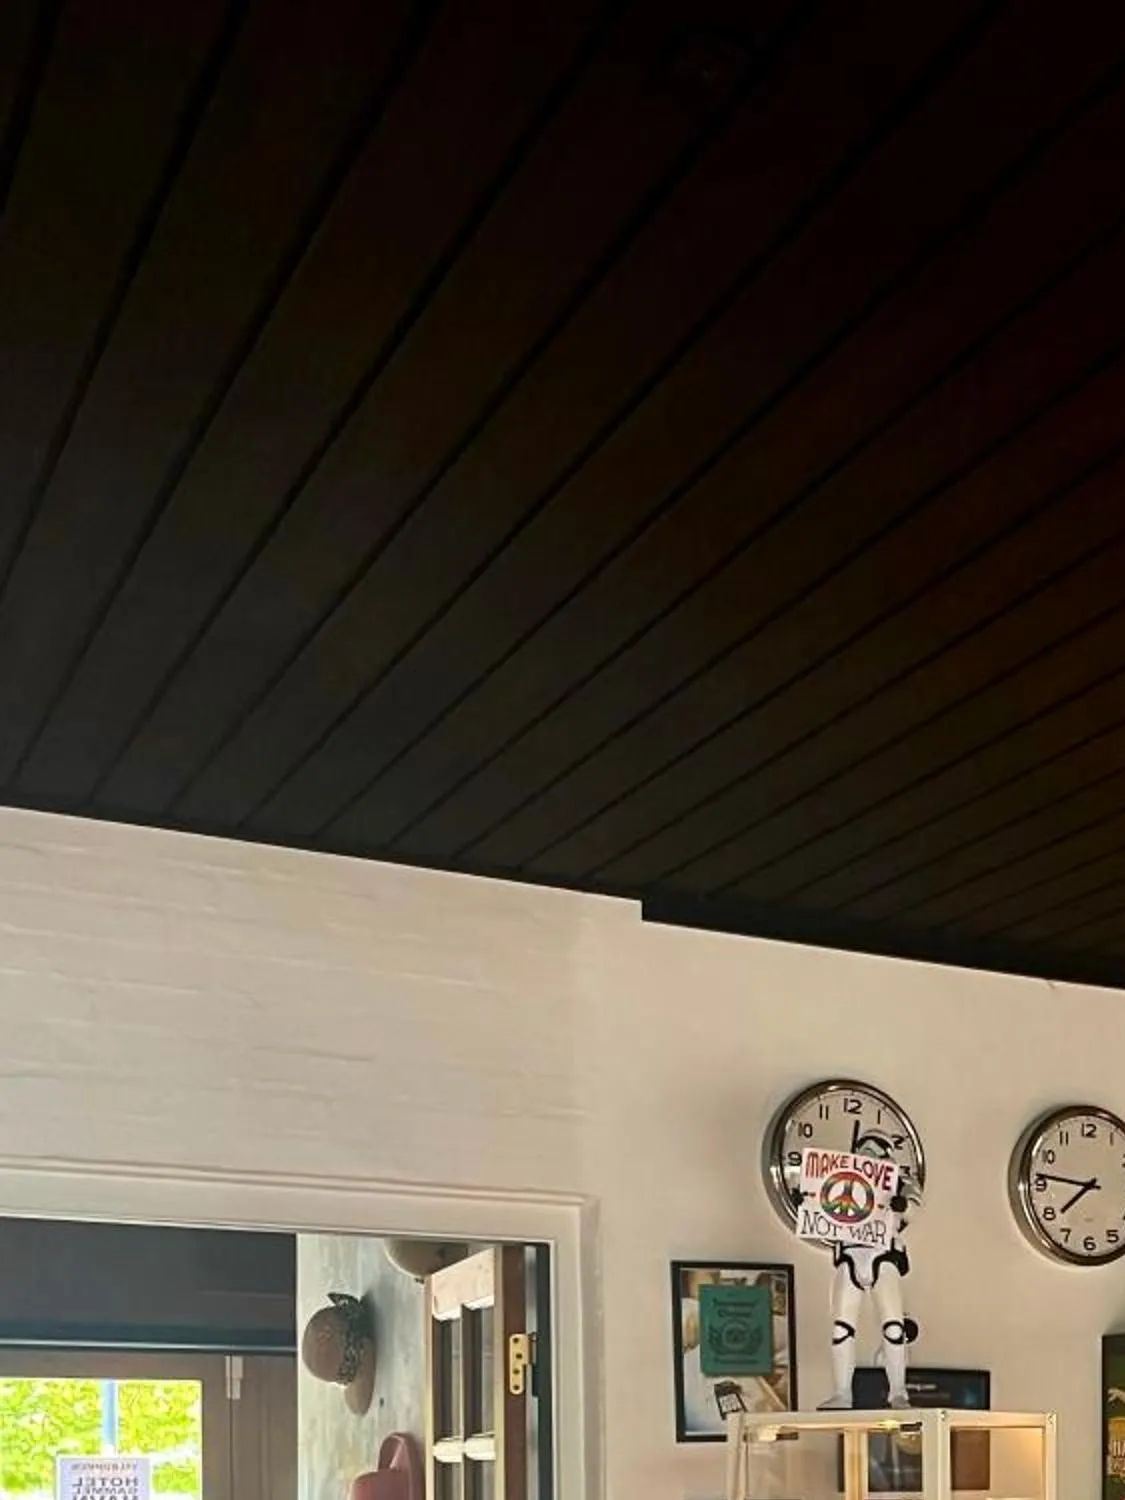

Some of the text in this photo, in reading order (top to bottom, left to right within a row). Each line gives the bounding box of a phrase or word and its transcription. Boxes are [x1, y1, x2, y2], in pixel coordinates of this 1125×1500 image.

[818, 1104, 829, 1120] 11
[843, 1097, 862, 1115] 12
[877, 1109, 882, 1125] 1
[798, 1122, 813, 1138] 10
[1081, 1123, 1097, 1138] 12
[1059, 1131, 1069, 1146] 11
[1109, 1131, 1114, 1146] 1
[788, 1151, 802, 1167] 9
[1042, 1149, 1055, 1164] 10
[805, 1151, 894, 1191] MAKE LOVE
[1034, 1175, 1047, 1192] 9
[1042, 1207, 1057, 1221] 8
[801, 1209, 887, 1246] NOT WAR
[1060, 1228, 1071, 1243] 7
[1106, 1229, 1119, 1243] 5
[1083, 1236, 1097, 1251] 6
